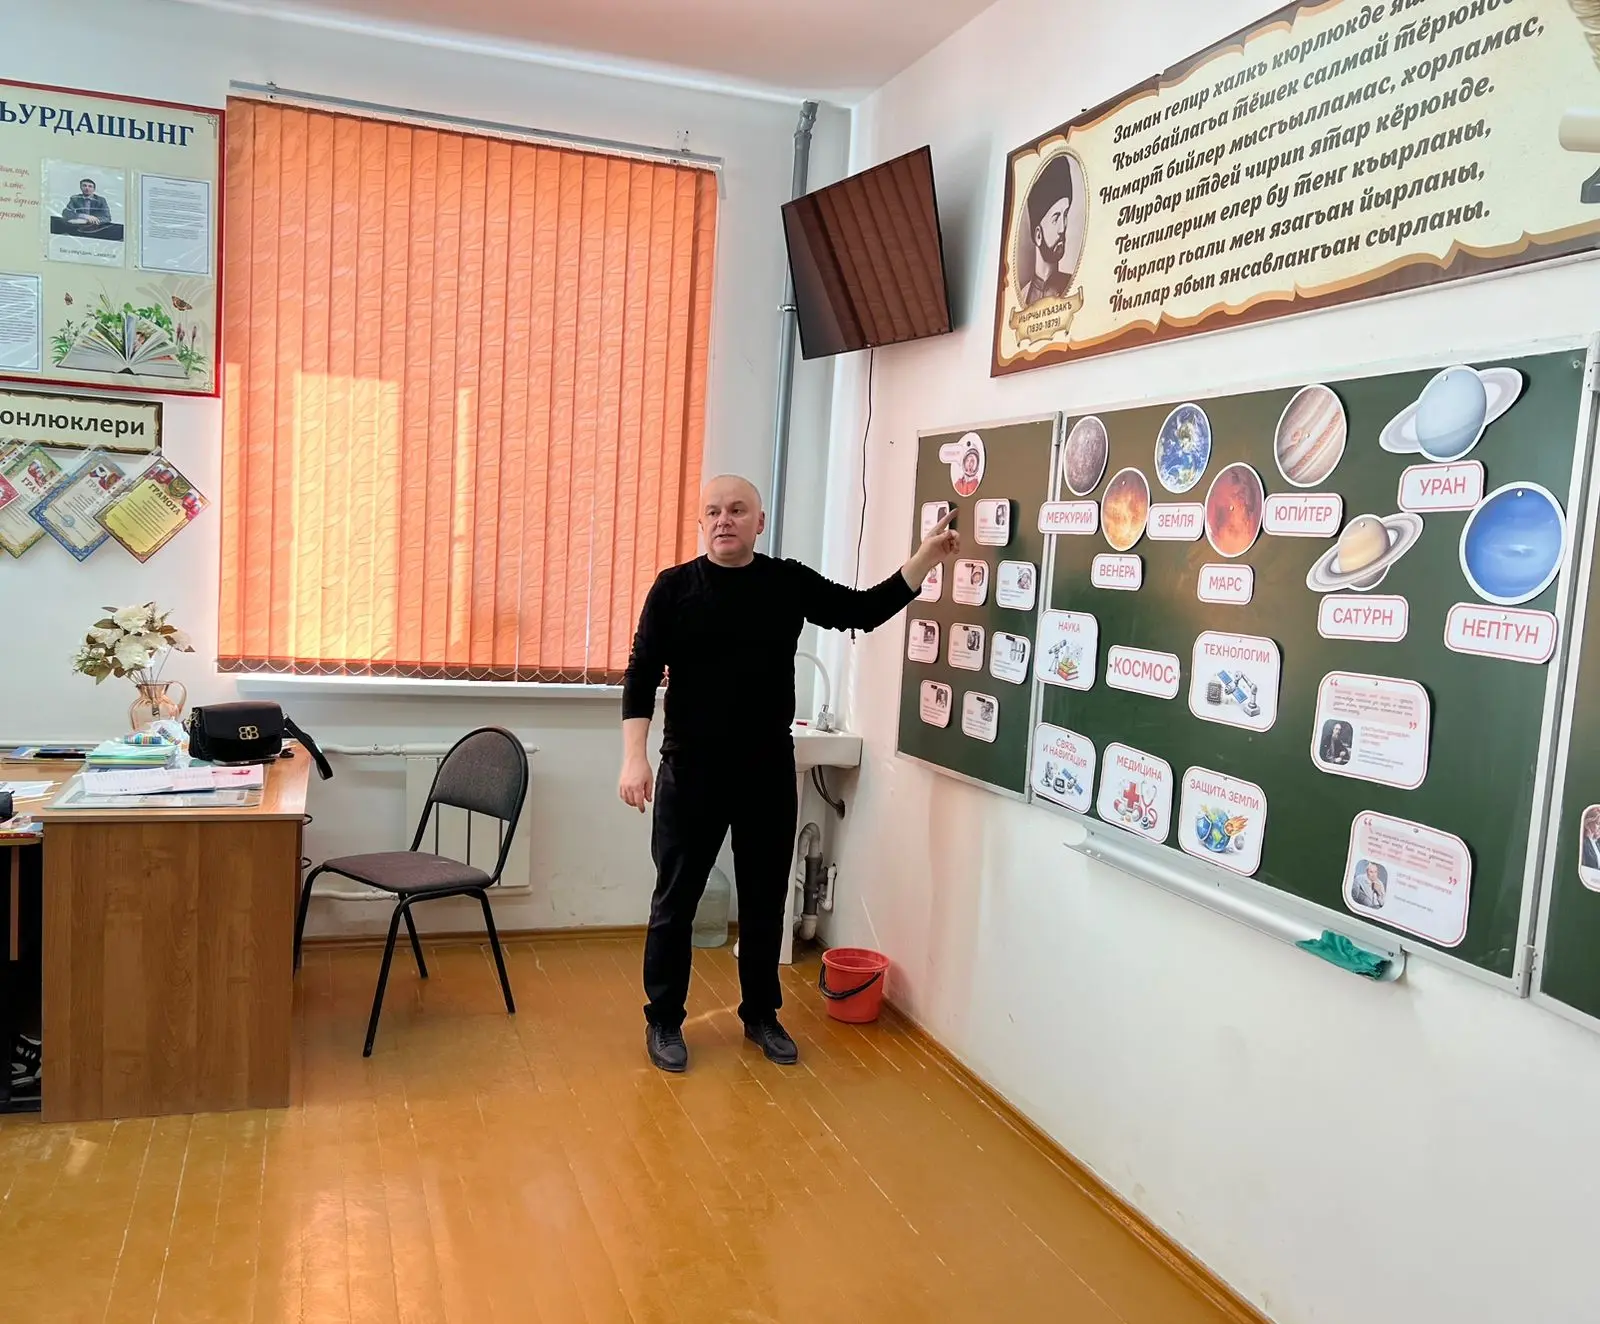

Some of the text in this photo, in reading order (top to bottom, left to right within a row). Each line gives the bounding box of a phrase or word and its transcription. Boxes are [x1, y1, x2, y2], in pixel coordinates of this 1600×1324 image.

[1113, 110, 1161, 144] Заман
[1164, 87, 1210, 121] гелир
[1212, 60, 1268, 99] халкъ
[1271, 4, 1386, 71] кюрлюкде
[1099, 15, 1545, 205] Намарт бийлер мысгъылламас, хорламас,
[1112, 108, 1229, 172] Къызбайлагъа
[1231, 78, 1300, 122] тёшек
[1303, 32, 1389, 90] салмай
[1116, 76, 1495, 227] Мурдар итдей чирип ятар кёрюнде.
[1115, 118, 1492, 255] Тенглилерим елер бу тенг къырланы,
[1113, 252, 1176, 284] Йырлар
[1228, 225, 1266, 251] мен
[1269, 198, 1355, 239] язагъан
[1359, 160, 1485, 213] йырланы,
[1108, 200, 1491, 313] Йыллар ябып янсавлангъан сырланы.
[1041, 301, 1073, 318] КЪАЗАКЪ
[1026, 315, 1061, 336] (1830-1879)
[0, 410, 145, 438] онлюклери
[148, 483, 181, 516] ГРАМОТА
[1419, 476, 1467, 497] УРАН
[1046, 508, 1093, 524] МЕРКУРИЙ
[1157, 513, 1195, 528] ЗЕМЛЯ
[1274, 505, 1333, 522] ЮПИТЕР
[1099, 564, 1136, 579] ВЕНЕРА
[1208, 575, 1243, 592] МАРС
[1058, 620, 1081, 634] НАУКА
[1332, 607, 1394, 626] САТУРН
[1461, 618, 1540, 645] НЕПТУН
[1203, 643, 1270, 664] ТЕХНОЛОГИИ
[1113, 656, 1174, 685] КОСМОС
[1042, 743, 1088, 769] И НАВИГАЦИЯ
[1055, 737, 1078, 754] СВЯЗЬ
[1116, 754, 1163, 783] МЕДИЦИНА
[1189, 778, 1260, 811] ЗАЩИТА ЗЕМЛИ
